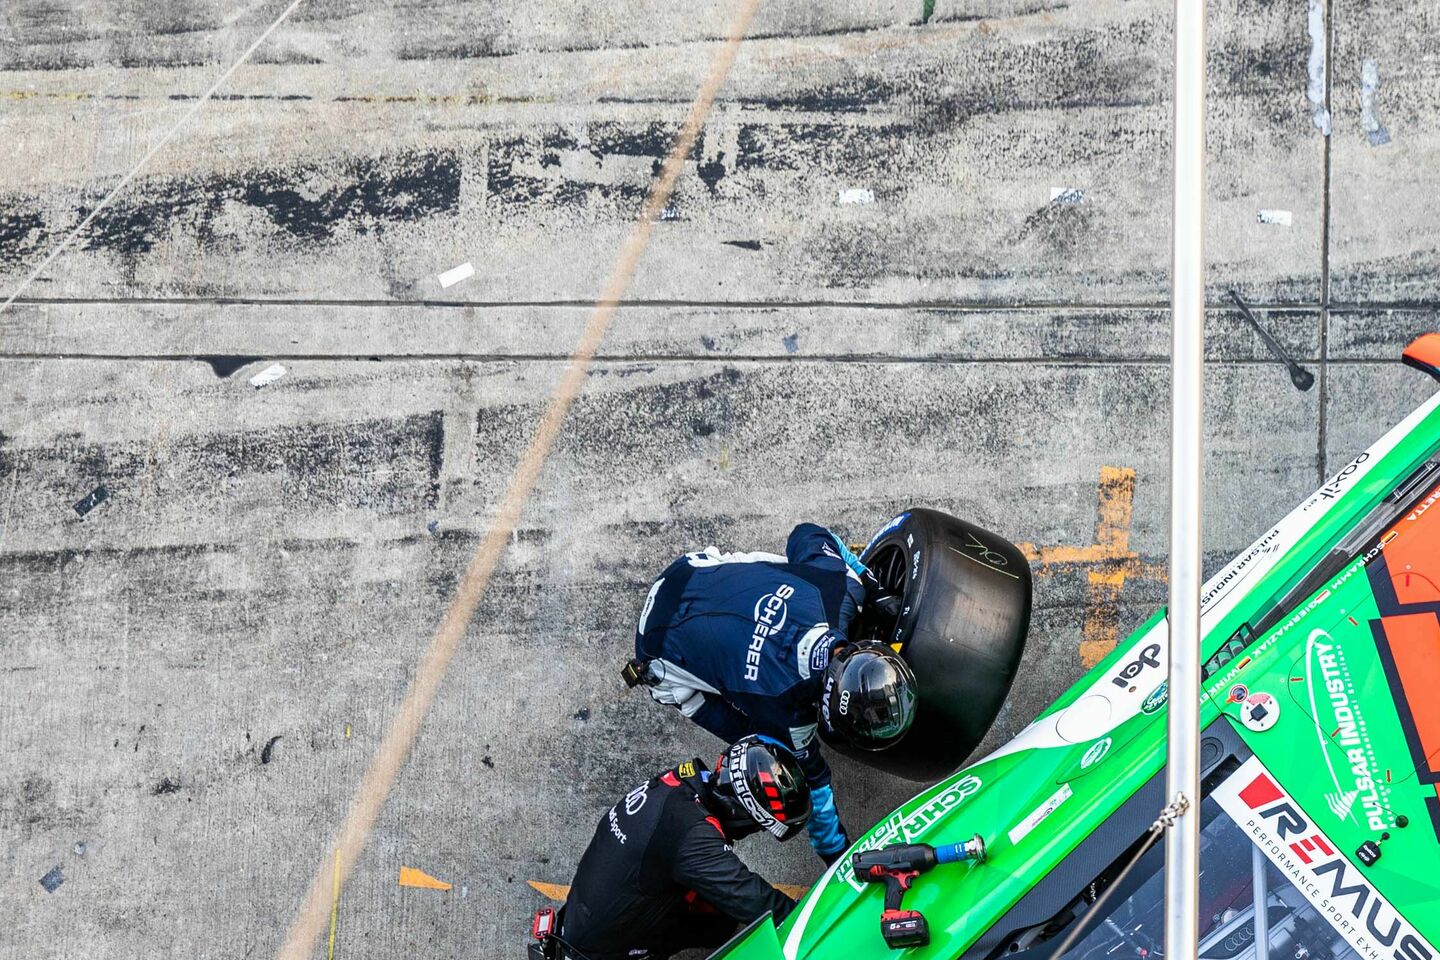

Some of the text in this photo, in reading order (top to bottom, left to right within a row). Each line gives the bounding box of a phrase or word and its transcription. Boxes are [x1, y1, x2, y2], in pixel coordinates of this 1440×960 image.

[1331, 541, 1387, 591] SCHRAMM
[743, 582, 796, 683] SCHERER
[1251, 598, 1320, 658] GIERMAZIAK
[1111, 643, 1162, 694] dai
[1313, 640, 1389, 832] PULSAR INDUSTRY
[1245, 818, 1322, 901] PERFORMANCE
[1320, 897, 1358, 941] SPORT
